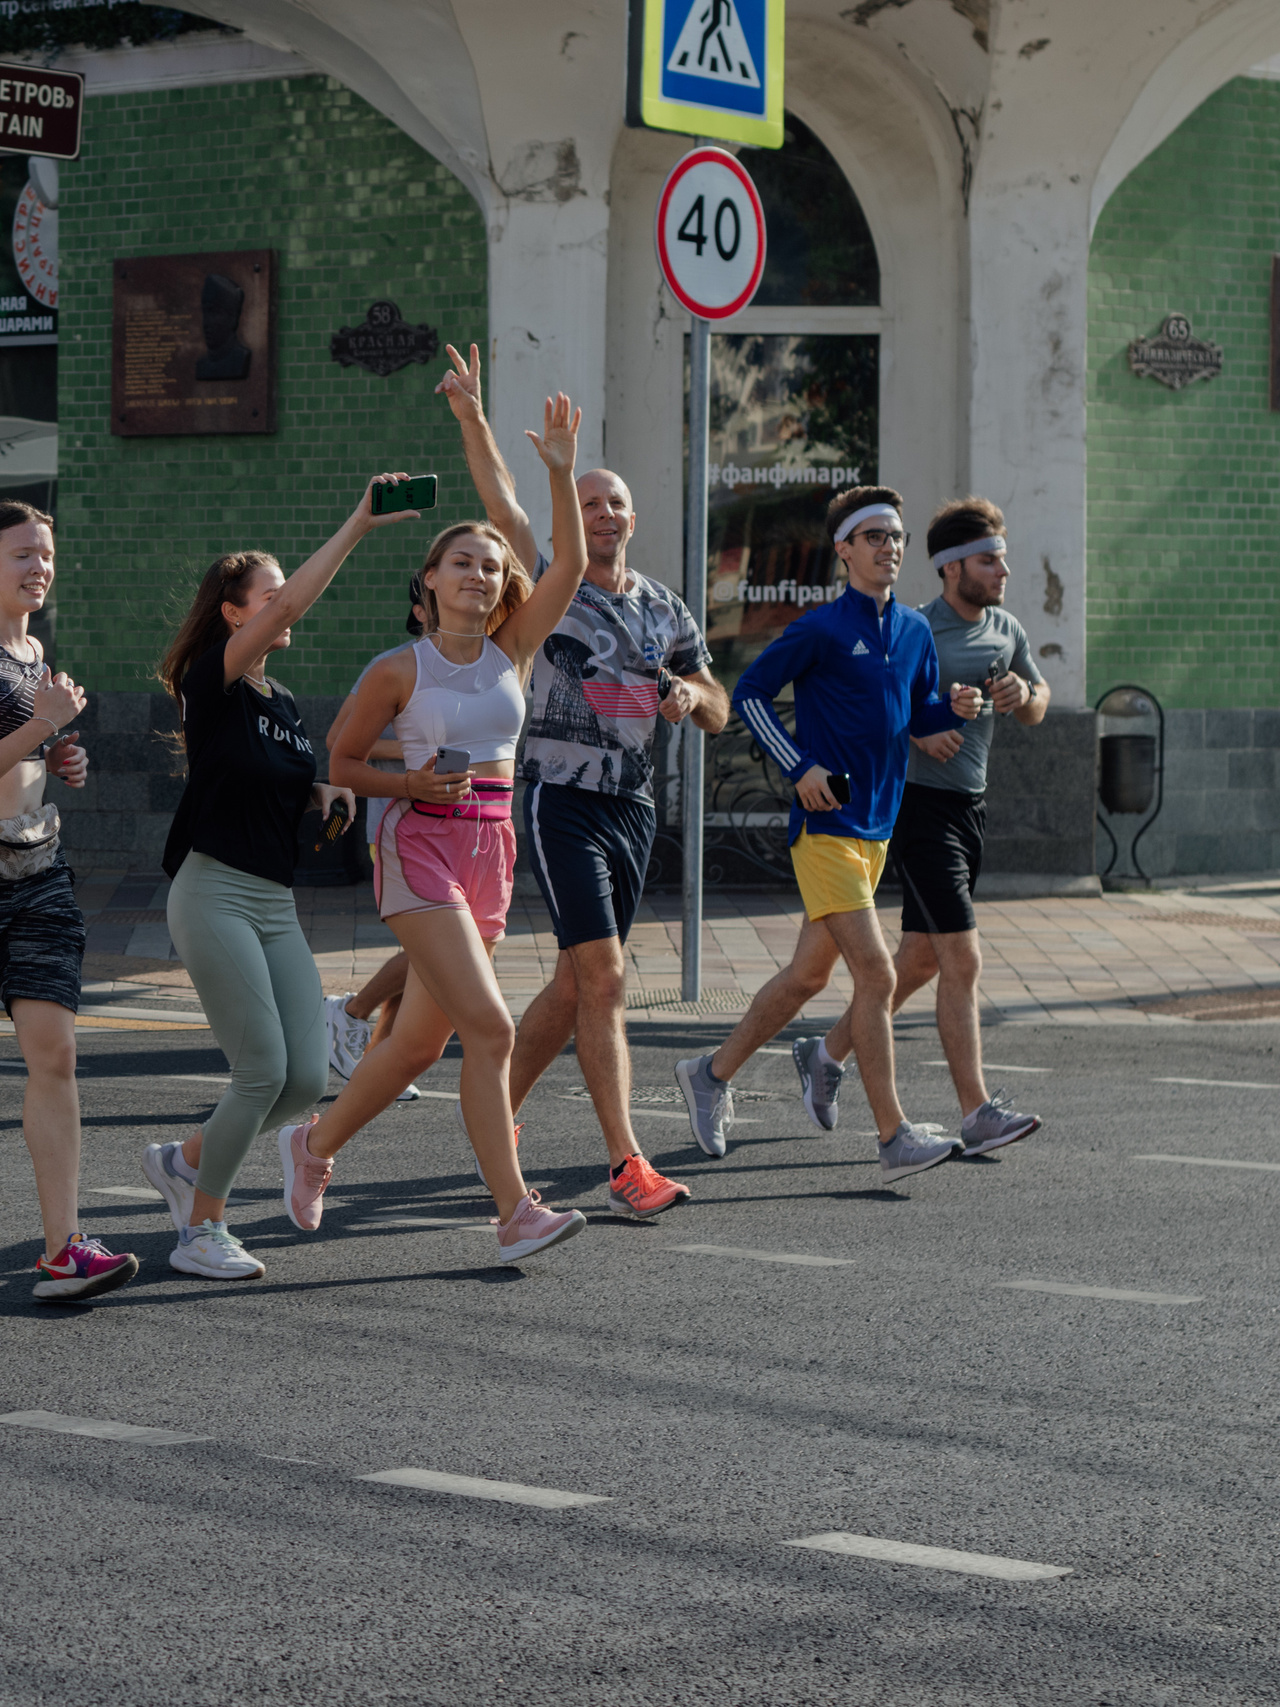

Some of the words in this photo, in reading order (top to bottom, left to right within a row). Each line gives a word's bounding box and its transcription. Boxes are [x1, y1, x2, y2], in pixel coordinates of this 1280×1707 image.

[677, 194, 741, 262] 40
[15, 186, 58, 306] АНТИСТРЕ
[372, 305, 391, 326] 58
[348, 333, 416, 349] КРАСНАЯ
[1168, 319, 1188, 341] 65
[708, 462, 860, 490] #фанфипарк
